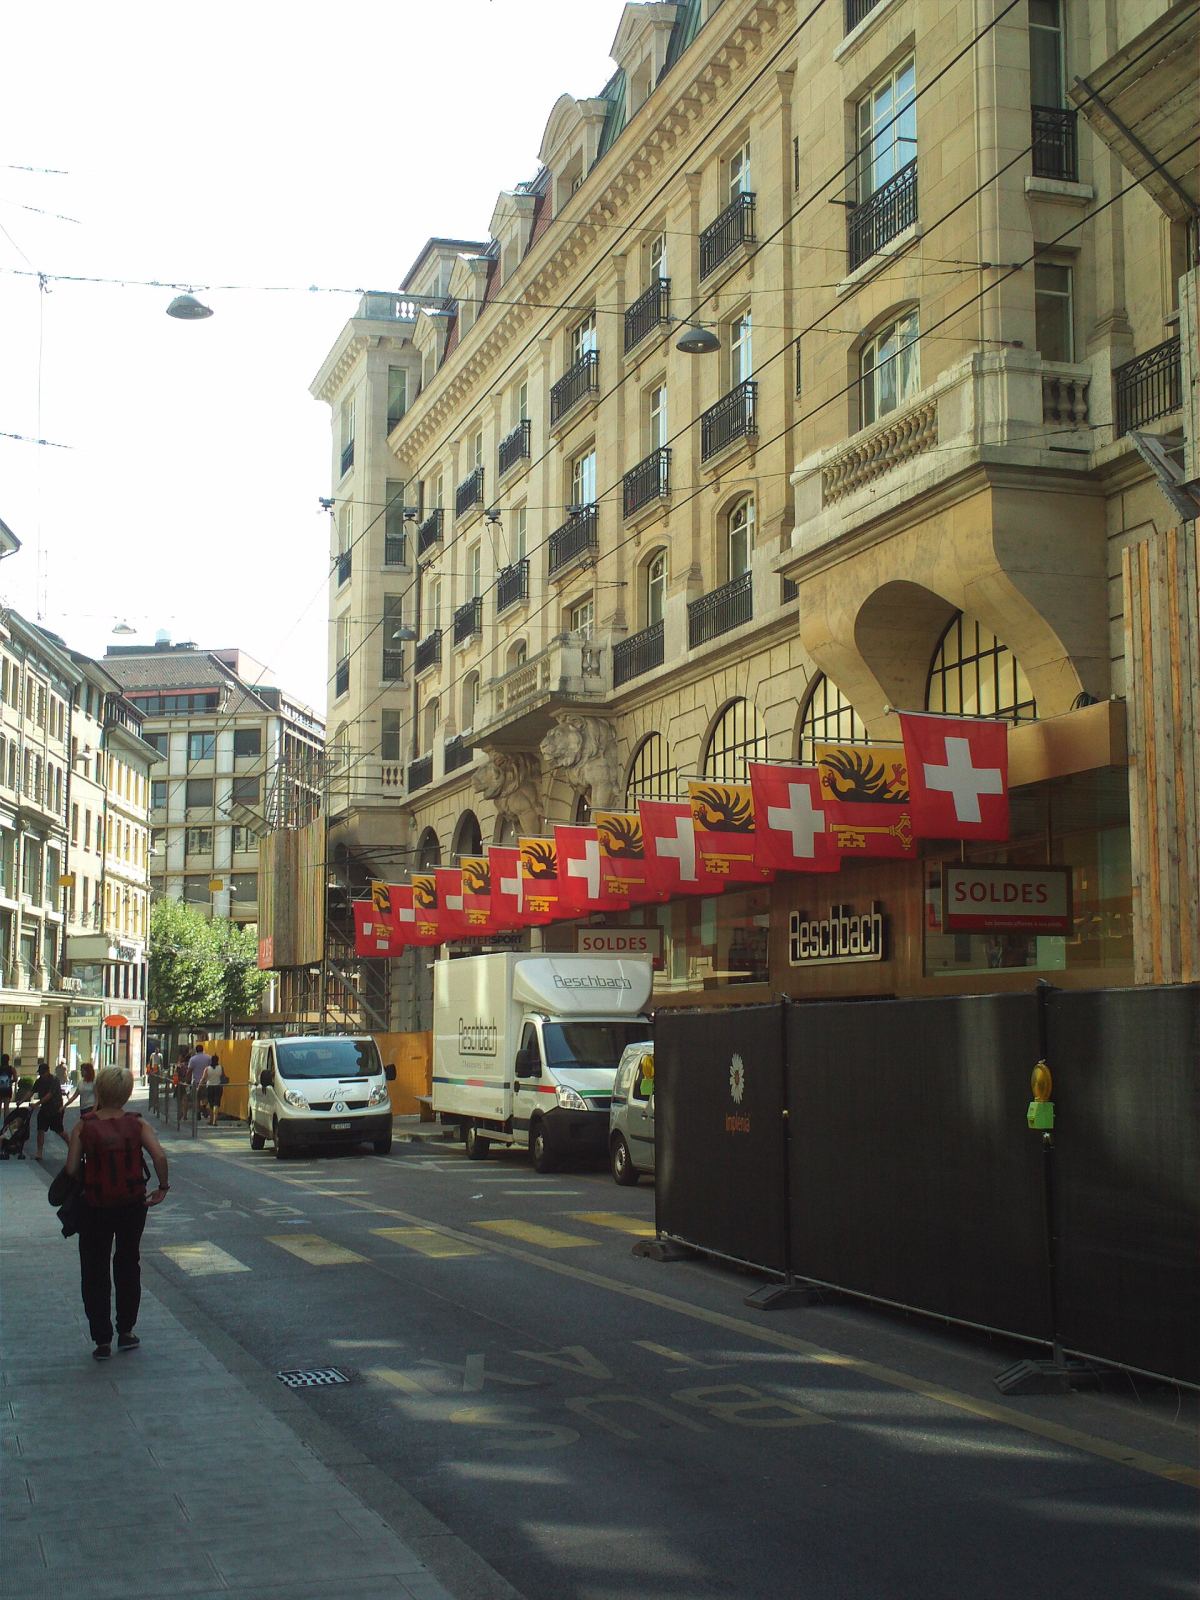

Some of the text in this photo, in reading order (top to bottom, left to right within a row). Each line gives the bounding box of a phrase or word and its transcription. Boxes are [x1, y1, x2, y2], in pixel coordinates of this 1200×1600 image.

[955, 882, 1048, 904] SOLDES
[582, 937, 648, 951] SOLDES
[789, 900, 883, 967] Aeschbach
[552, 974, 633, 990] Aeschbach
[459, 1016, 498, 1057] Aeschbach
[370, 1340, 739, 1397] TAXI
[448, 1384, 836, 1451] BUS
